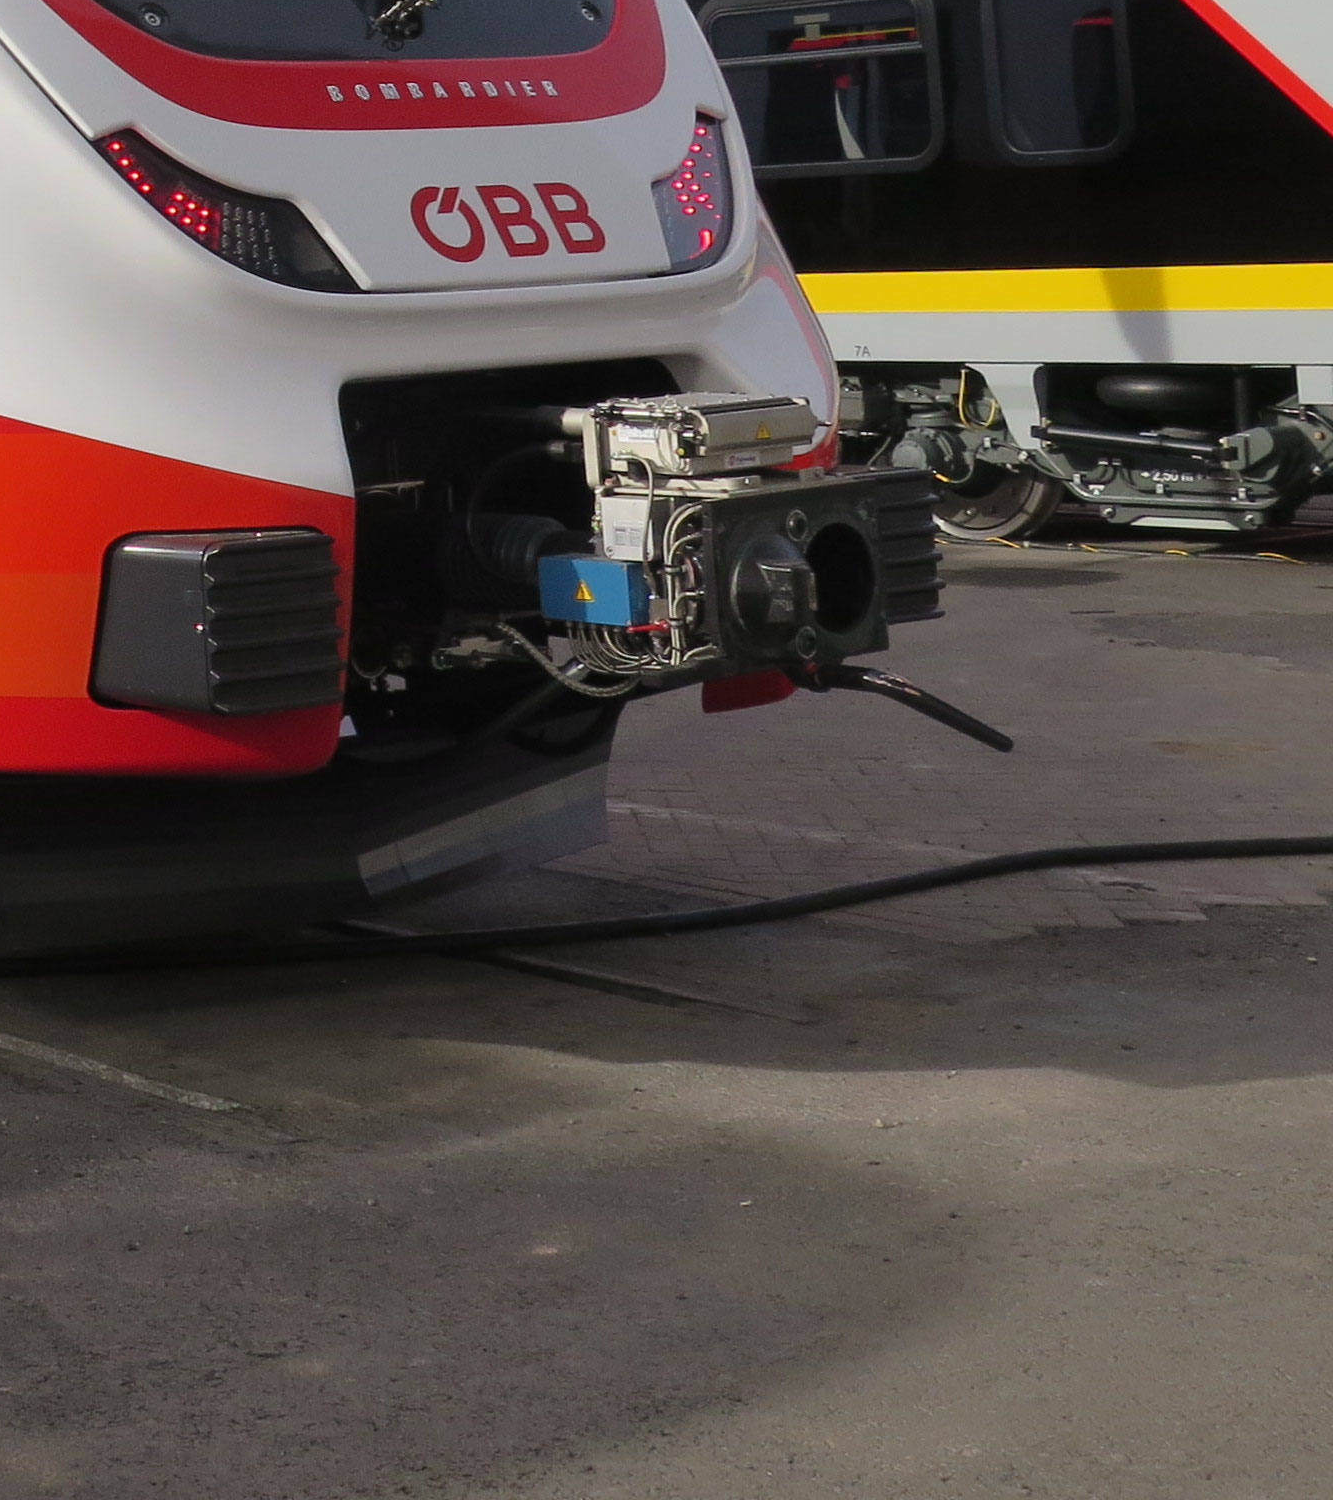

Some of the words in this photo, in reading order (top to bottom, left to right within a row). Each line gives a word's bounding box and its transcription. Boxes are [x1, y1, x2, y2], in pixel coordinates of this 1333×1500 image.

[326, 81, 558, 101] BOMBARDIER
[410, 183, 606, 263] ÖBB
[854, 345, 871, 357] 7A
